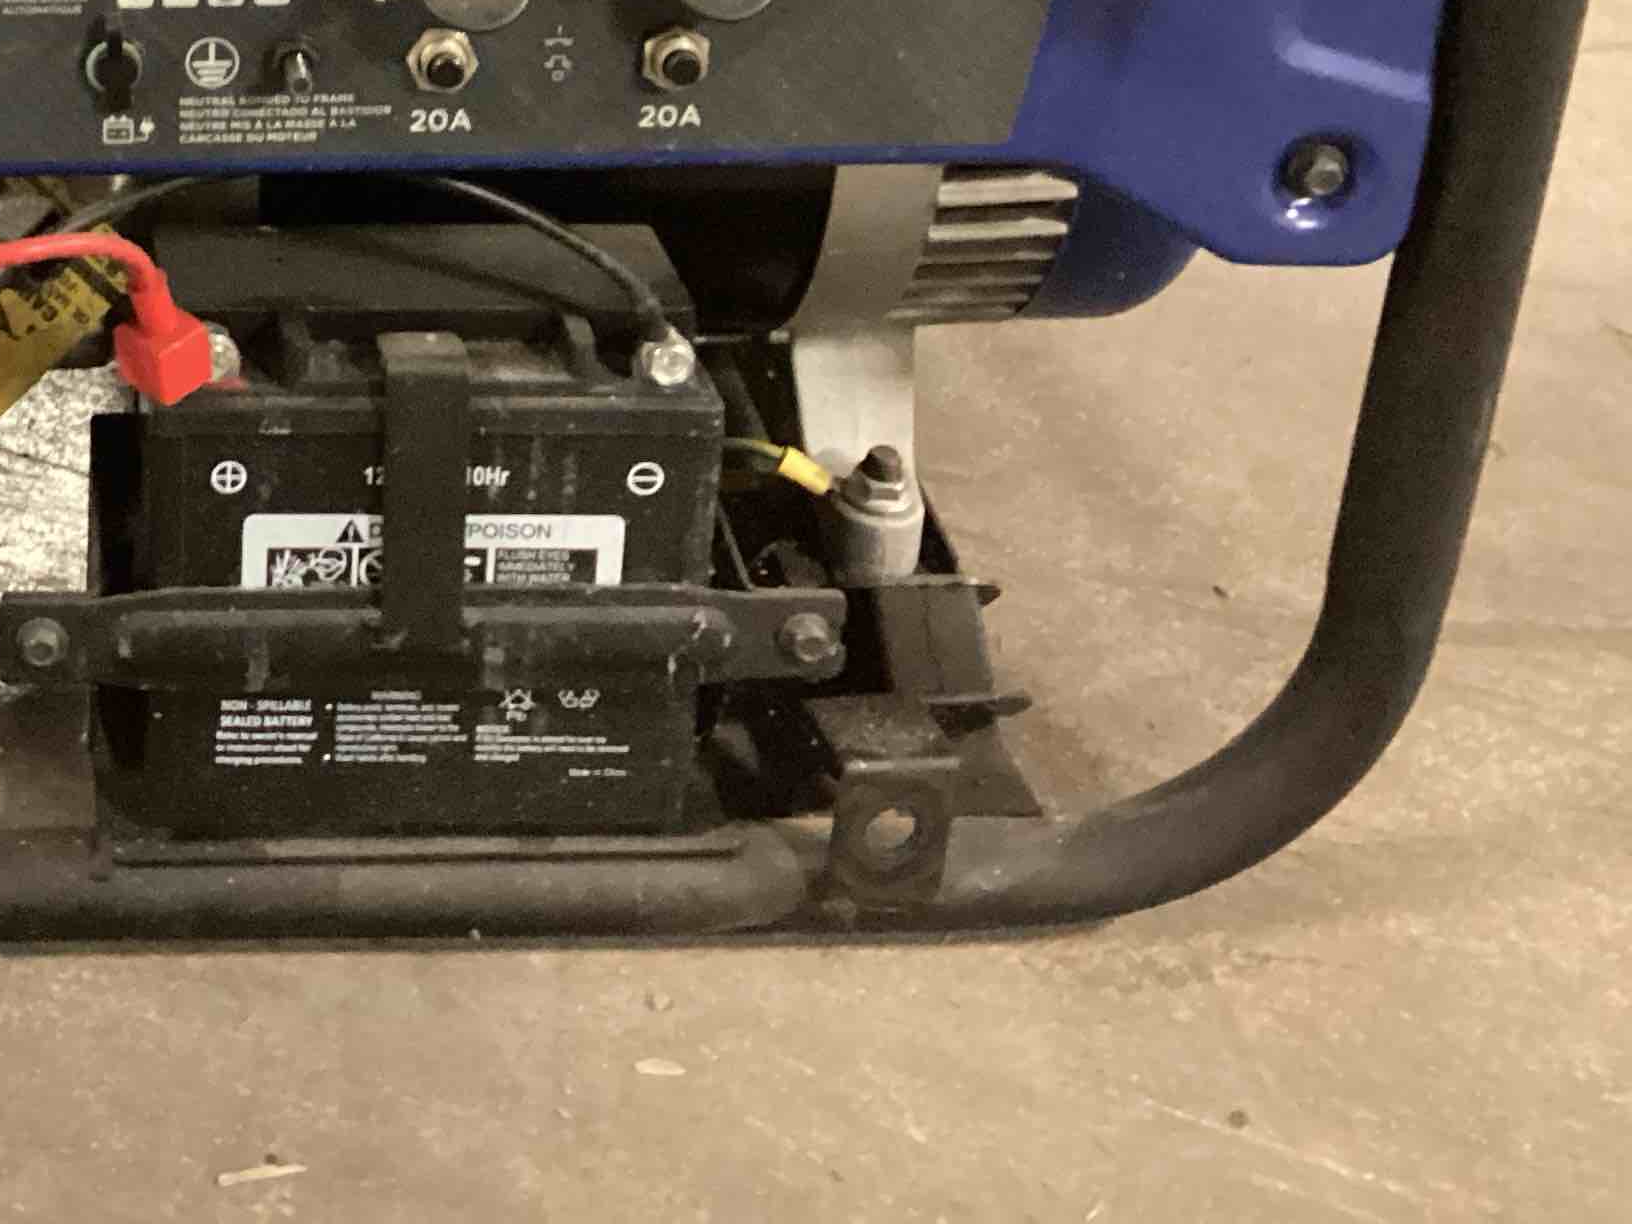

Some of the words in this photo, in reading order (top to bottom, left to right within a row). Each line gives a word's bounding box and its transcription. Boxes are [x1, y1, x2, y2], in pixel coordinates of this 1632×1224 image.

[409, 108, 472, 133] 20A
[637, 103, 702, 128] 20A
[469, 521, 552, 539] POISON
[220, 699, 248, 712] NON
[255, 699, 312, 713] SPILLABLE
[220, 714, 262, 728] SEALED
[263, 714, 313, 728] BATTERY
